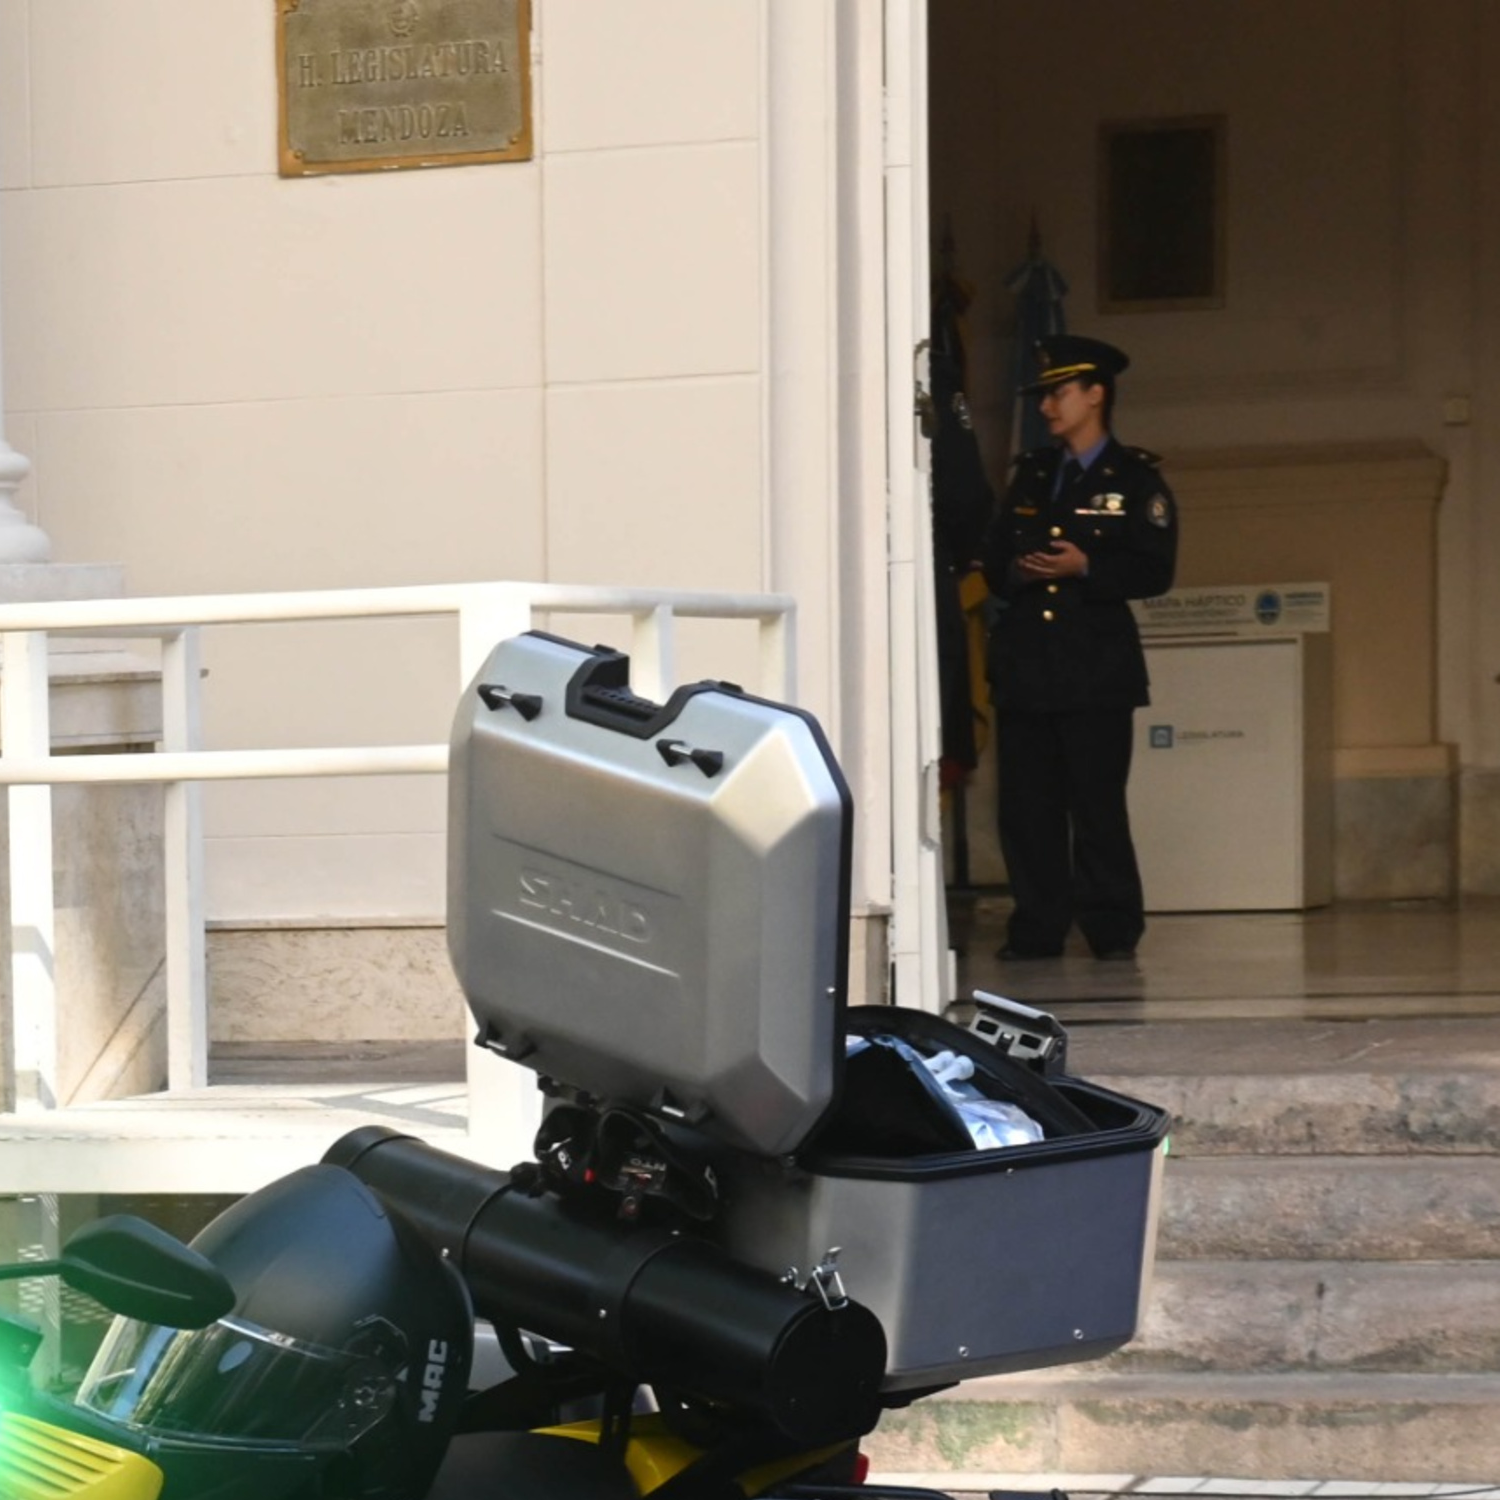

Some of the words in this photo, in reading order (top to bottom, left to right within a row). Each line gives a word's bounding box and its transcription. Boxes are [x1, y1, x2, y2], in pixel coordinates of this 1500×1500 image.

[299, 53, 323, 88] H.
[331, 39, 508, 86] LEGISLATURA
[338, 102, 469, 144] MENDOZA
[518, 865, 652, 944] SHAD
[418, 1339, 447, 1422] MAC
